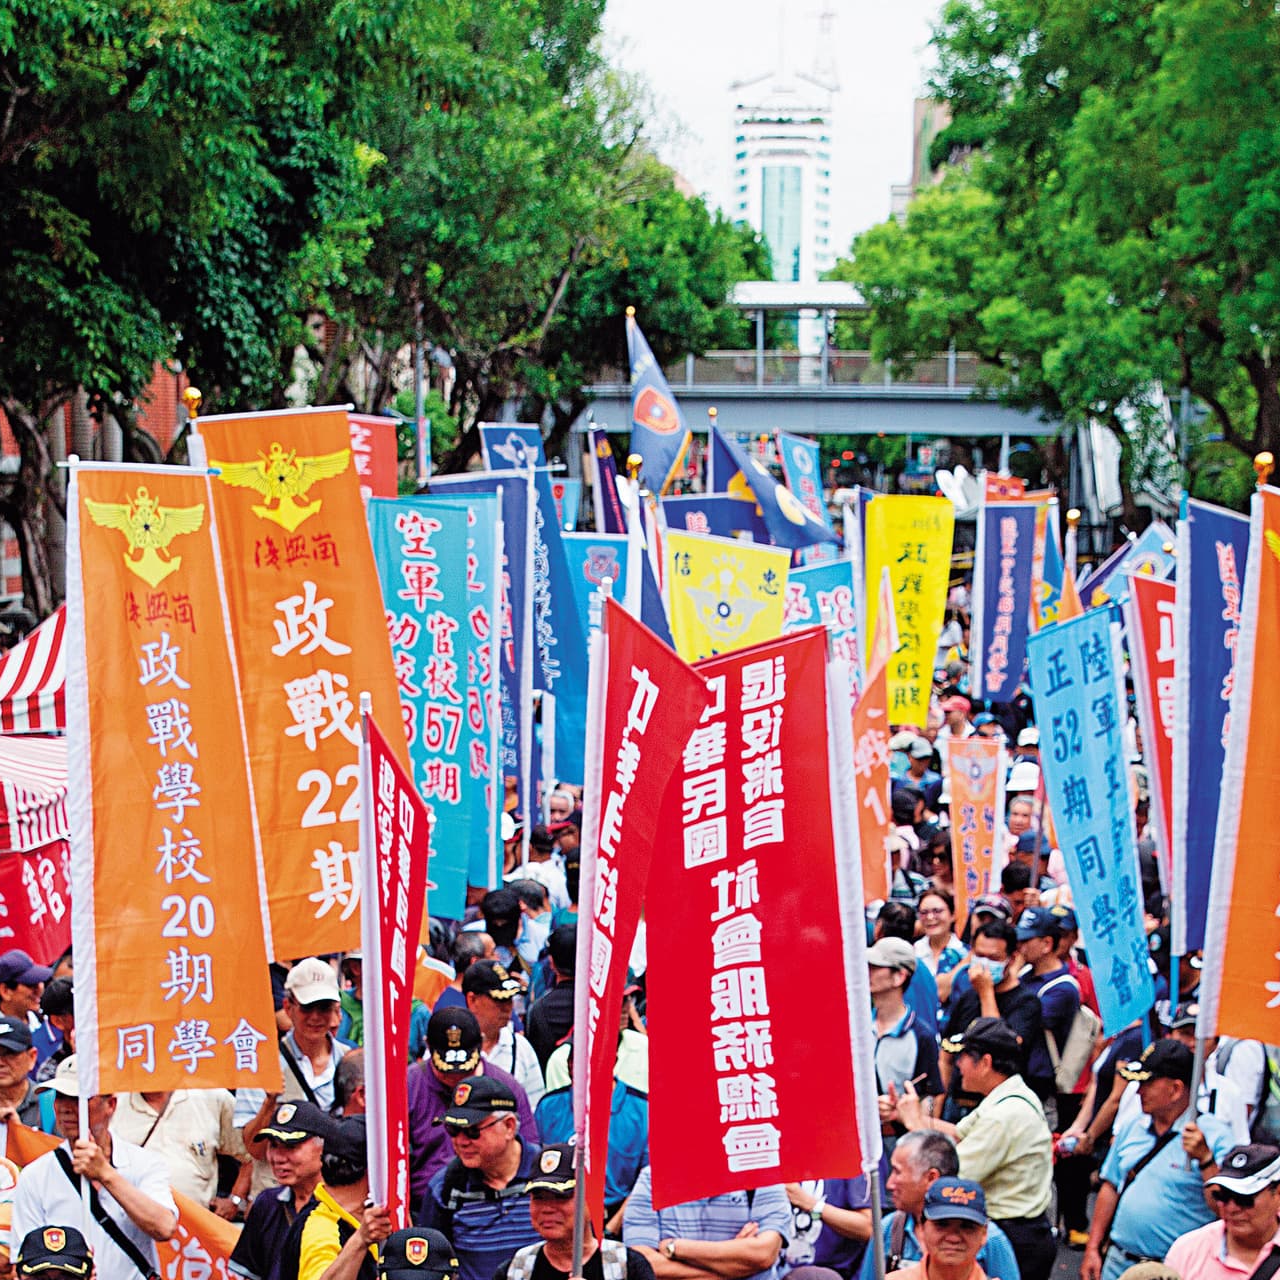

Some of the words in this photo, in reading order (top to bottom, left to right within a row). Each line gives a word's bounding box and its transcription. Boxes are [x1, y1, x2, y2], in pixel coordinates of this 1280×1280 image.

[396, 510, 442, 612] 空軍
[138, 631, 215, 1004] 政戰學校20期
[271, 580, 361, 921] 政戰22期
[1044, 648, 1132, 1008] 正52期同學會
[116, 1017, 268, 1075] 同學會
